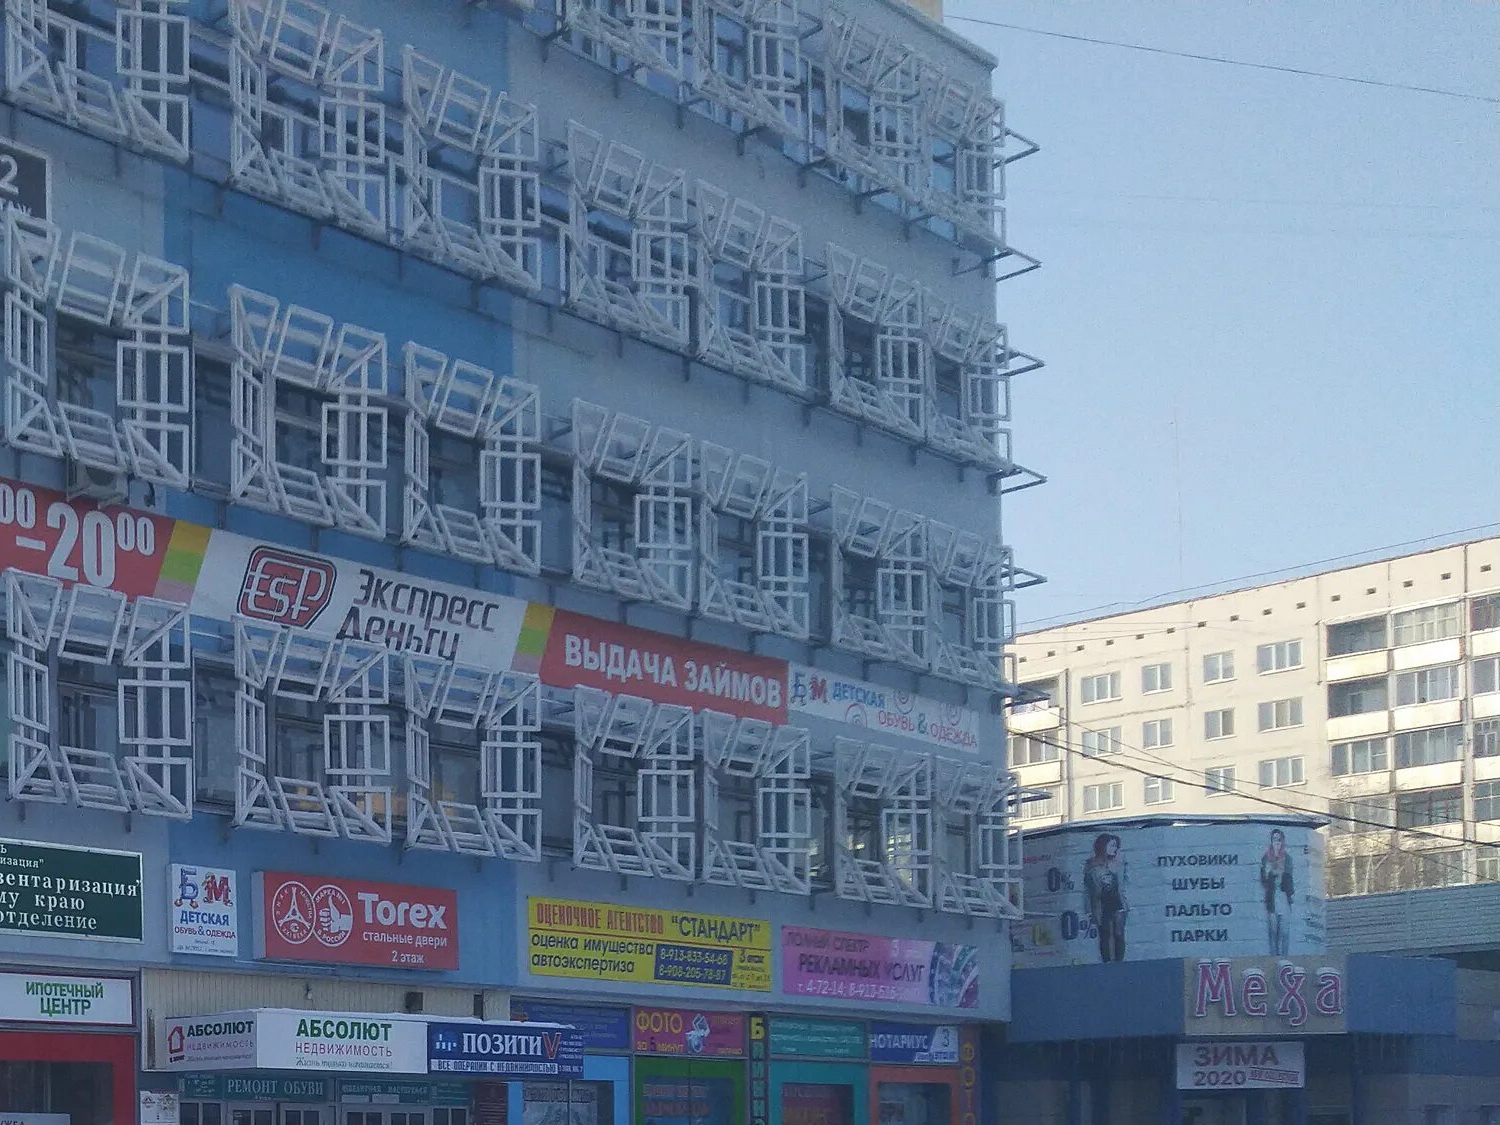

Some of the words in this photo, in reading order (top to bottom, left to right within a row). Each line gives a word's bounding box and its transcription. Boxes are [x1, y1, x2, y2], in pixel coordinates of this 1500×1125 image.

[0, 153, 20, 194] 2
[351, 567, 500, 632] Экспресс
[336, 606, 460, 661] Деньги
[564, 633, 677, 688] ВЫДАЧА
[685, 660, 783, 708] ЗАЙМОВ
[833, 680, 886, 709] ДЕТСКАЯ
[877, 709, 916, 731] ОБУВЬ
[930, 722, 978, 748] ОДЕЖДА
[1157, 854, 1239, 867] ПУХОВИКИ
[1171, 877, 1225, 891] ШУБЫ
[34, 893, 86, 912] краю
[358, 891, 447, 930] Torex
[1165, 903, 1232, 918] ПАЛЬТО
[180, 911, 230, 926] ДЕТСКАЯ
[537, 902, 601, 929] ОЦЕНОЧНОЕ
[607, 910, 663, 934] АГЕНТСТВО
[174, 926, 197, 935] ОБУВЬ
[197, 925, 205, 936] &
[205, 929, 236, 939] ОДЕЖДА
[362, 932, 412, 944] стальные
[415, 935, 447, 948] двери
[1171, 928, 1228, 943] ПАРКИ
[531, 932, 578, 951] оценка
[584, 937, 654, 956] имущества
[391, 950, 397, 962] 2
[399, 953, 425, 964] этаж
[531, 951, 635, 975] автоэкспертиза
[25, 980, 105, 1000] ИПОТЕЧНЫЙ
[1196, 959, 1344, 1026] Меха
[40, 998, 92, 1017] ЦЕНТР
[187, 1020, 254, 1038] АБСОЛЮТ
[296, 1018, 392, 1041] АБСОЛЮТ
[636, 1010, 683, 1034] ФОТО
[186, 1039, 254, 1051] НЕДВИЖИМОСТЬ
[869, 1033, 928, 1050] НОТАРИУС
[941, 1029, 950, 1048] 3
[295, 1042, 393, 1057] НЕДВИЖИМОСТЬ
[1194, 1046, 1279, 1067] ЗИМА
[437, 1060, 451, 1070] ВСЕ
[453, 1061, 488, 1072] ОПЕРАЦИИ
[497, 1062, 556, 1074] НЕДВИЖИМОСТЬЮ
[228, 1079, 279, 1094] РЕМОНТ
[284, 1080, 324, 1095] ОБУВИ
[1194, 1070, 1247, 1087] 2020
